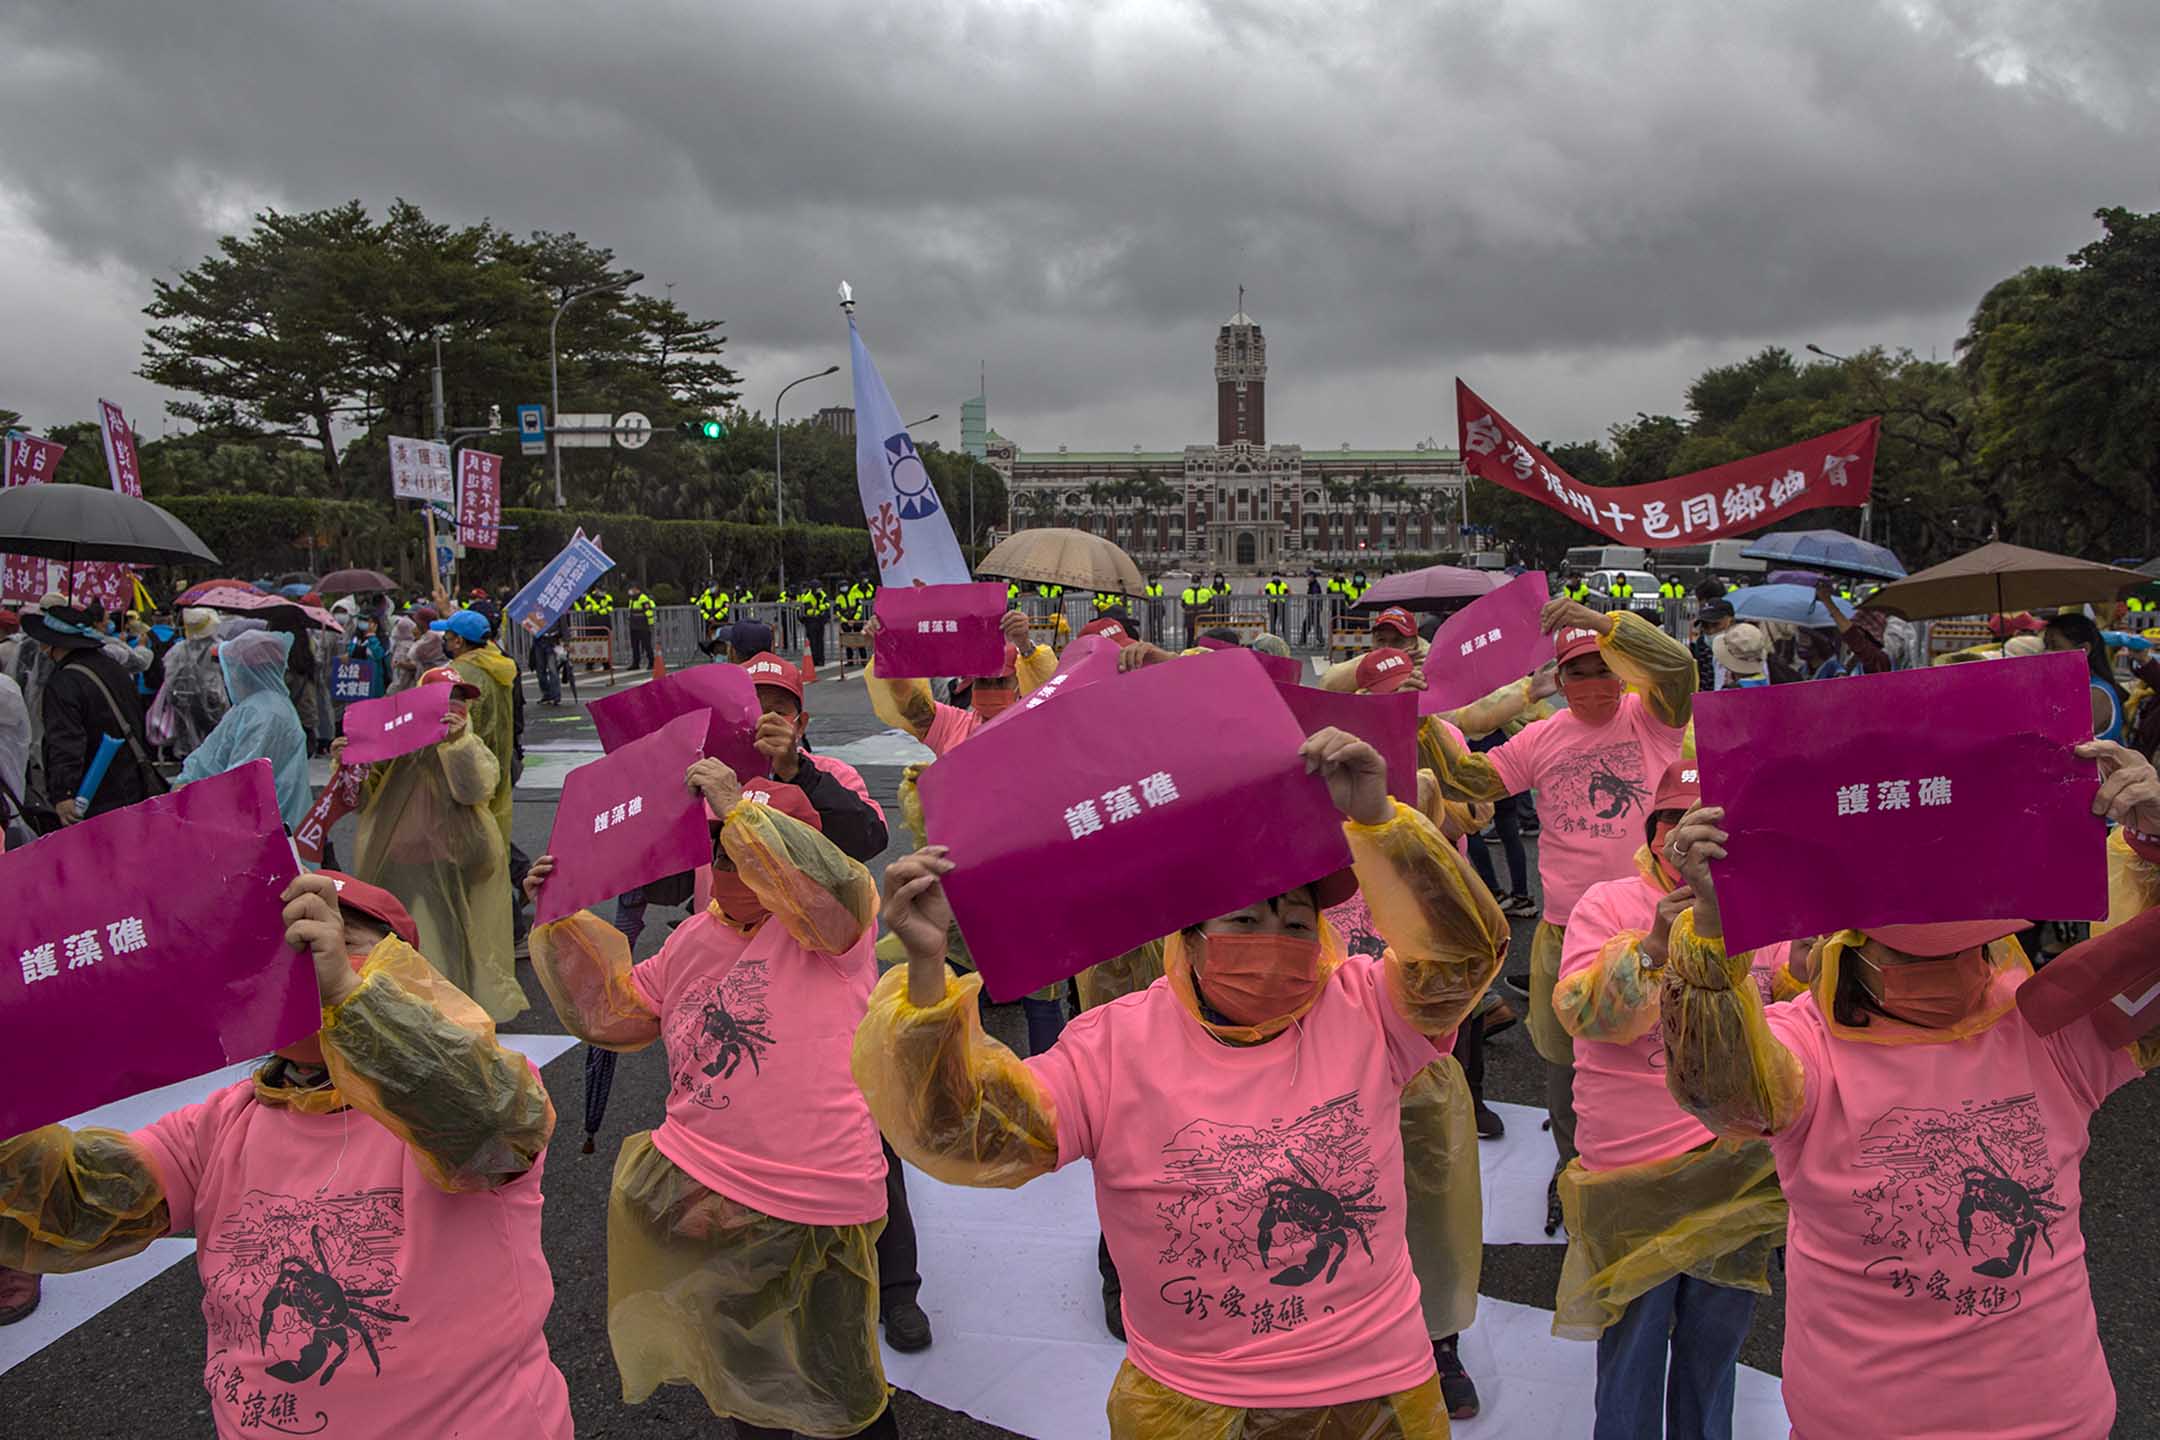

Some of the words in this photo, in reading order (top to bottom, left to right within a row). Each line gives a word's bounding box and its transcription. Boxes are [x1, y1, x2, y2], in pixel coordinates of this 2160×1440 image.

[918, 620, 958, 633] 護藻礁
[1459, 628, 1502, 656] 護藻礁
[336, 663, 361, 679] 公投
[593, 795, 643, 834] 護藻礁
[1063, 771, 1181, 840] 護藻礁
[1836, 775, 1953, 817] 護藻礁
[19, 916, 149, 985] 護藻礁
[1172, 1282, 1309, 1335] 珍愛藻礁
[1882, 1264, 2010, 1317] 珍愛藻礁
